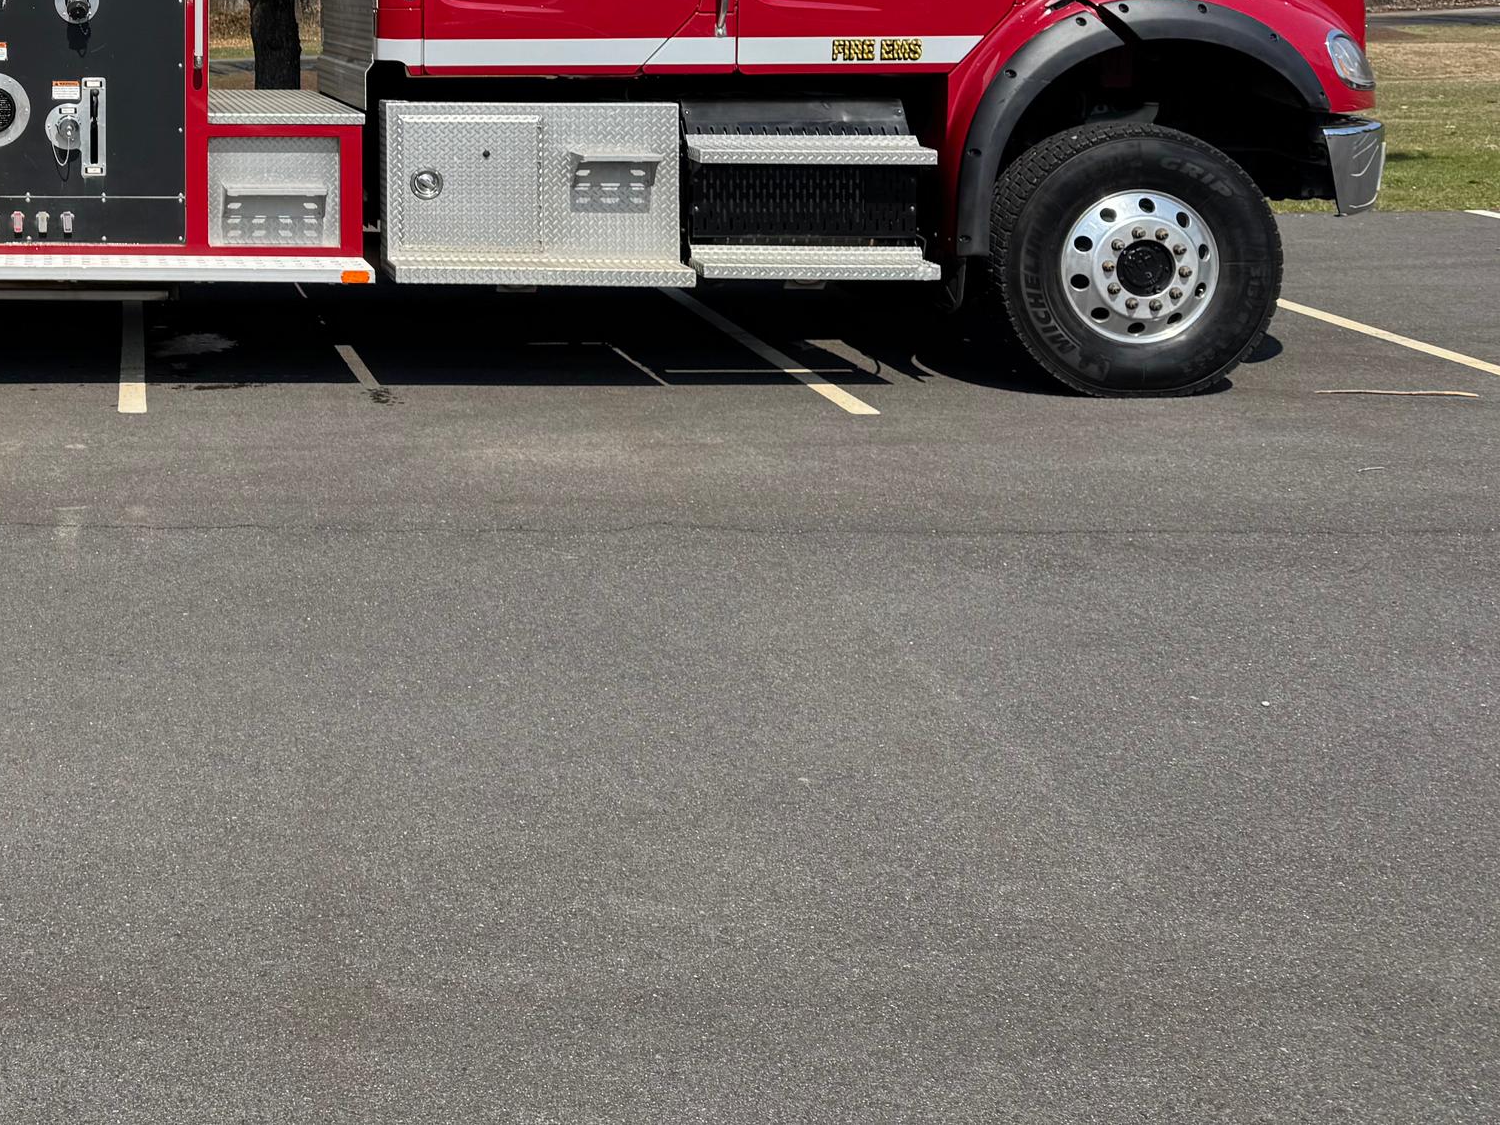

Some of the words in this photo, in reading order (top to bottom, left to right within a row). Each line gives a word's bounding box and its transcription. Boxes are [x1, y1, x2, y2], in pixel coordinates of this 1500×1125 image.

[832, 38, 875, 61] FIRE
[880, 38, 923, 61] EMS
[1160, 156, 1235, 198] GRIP
